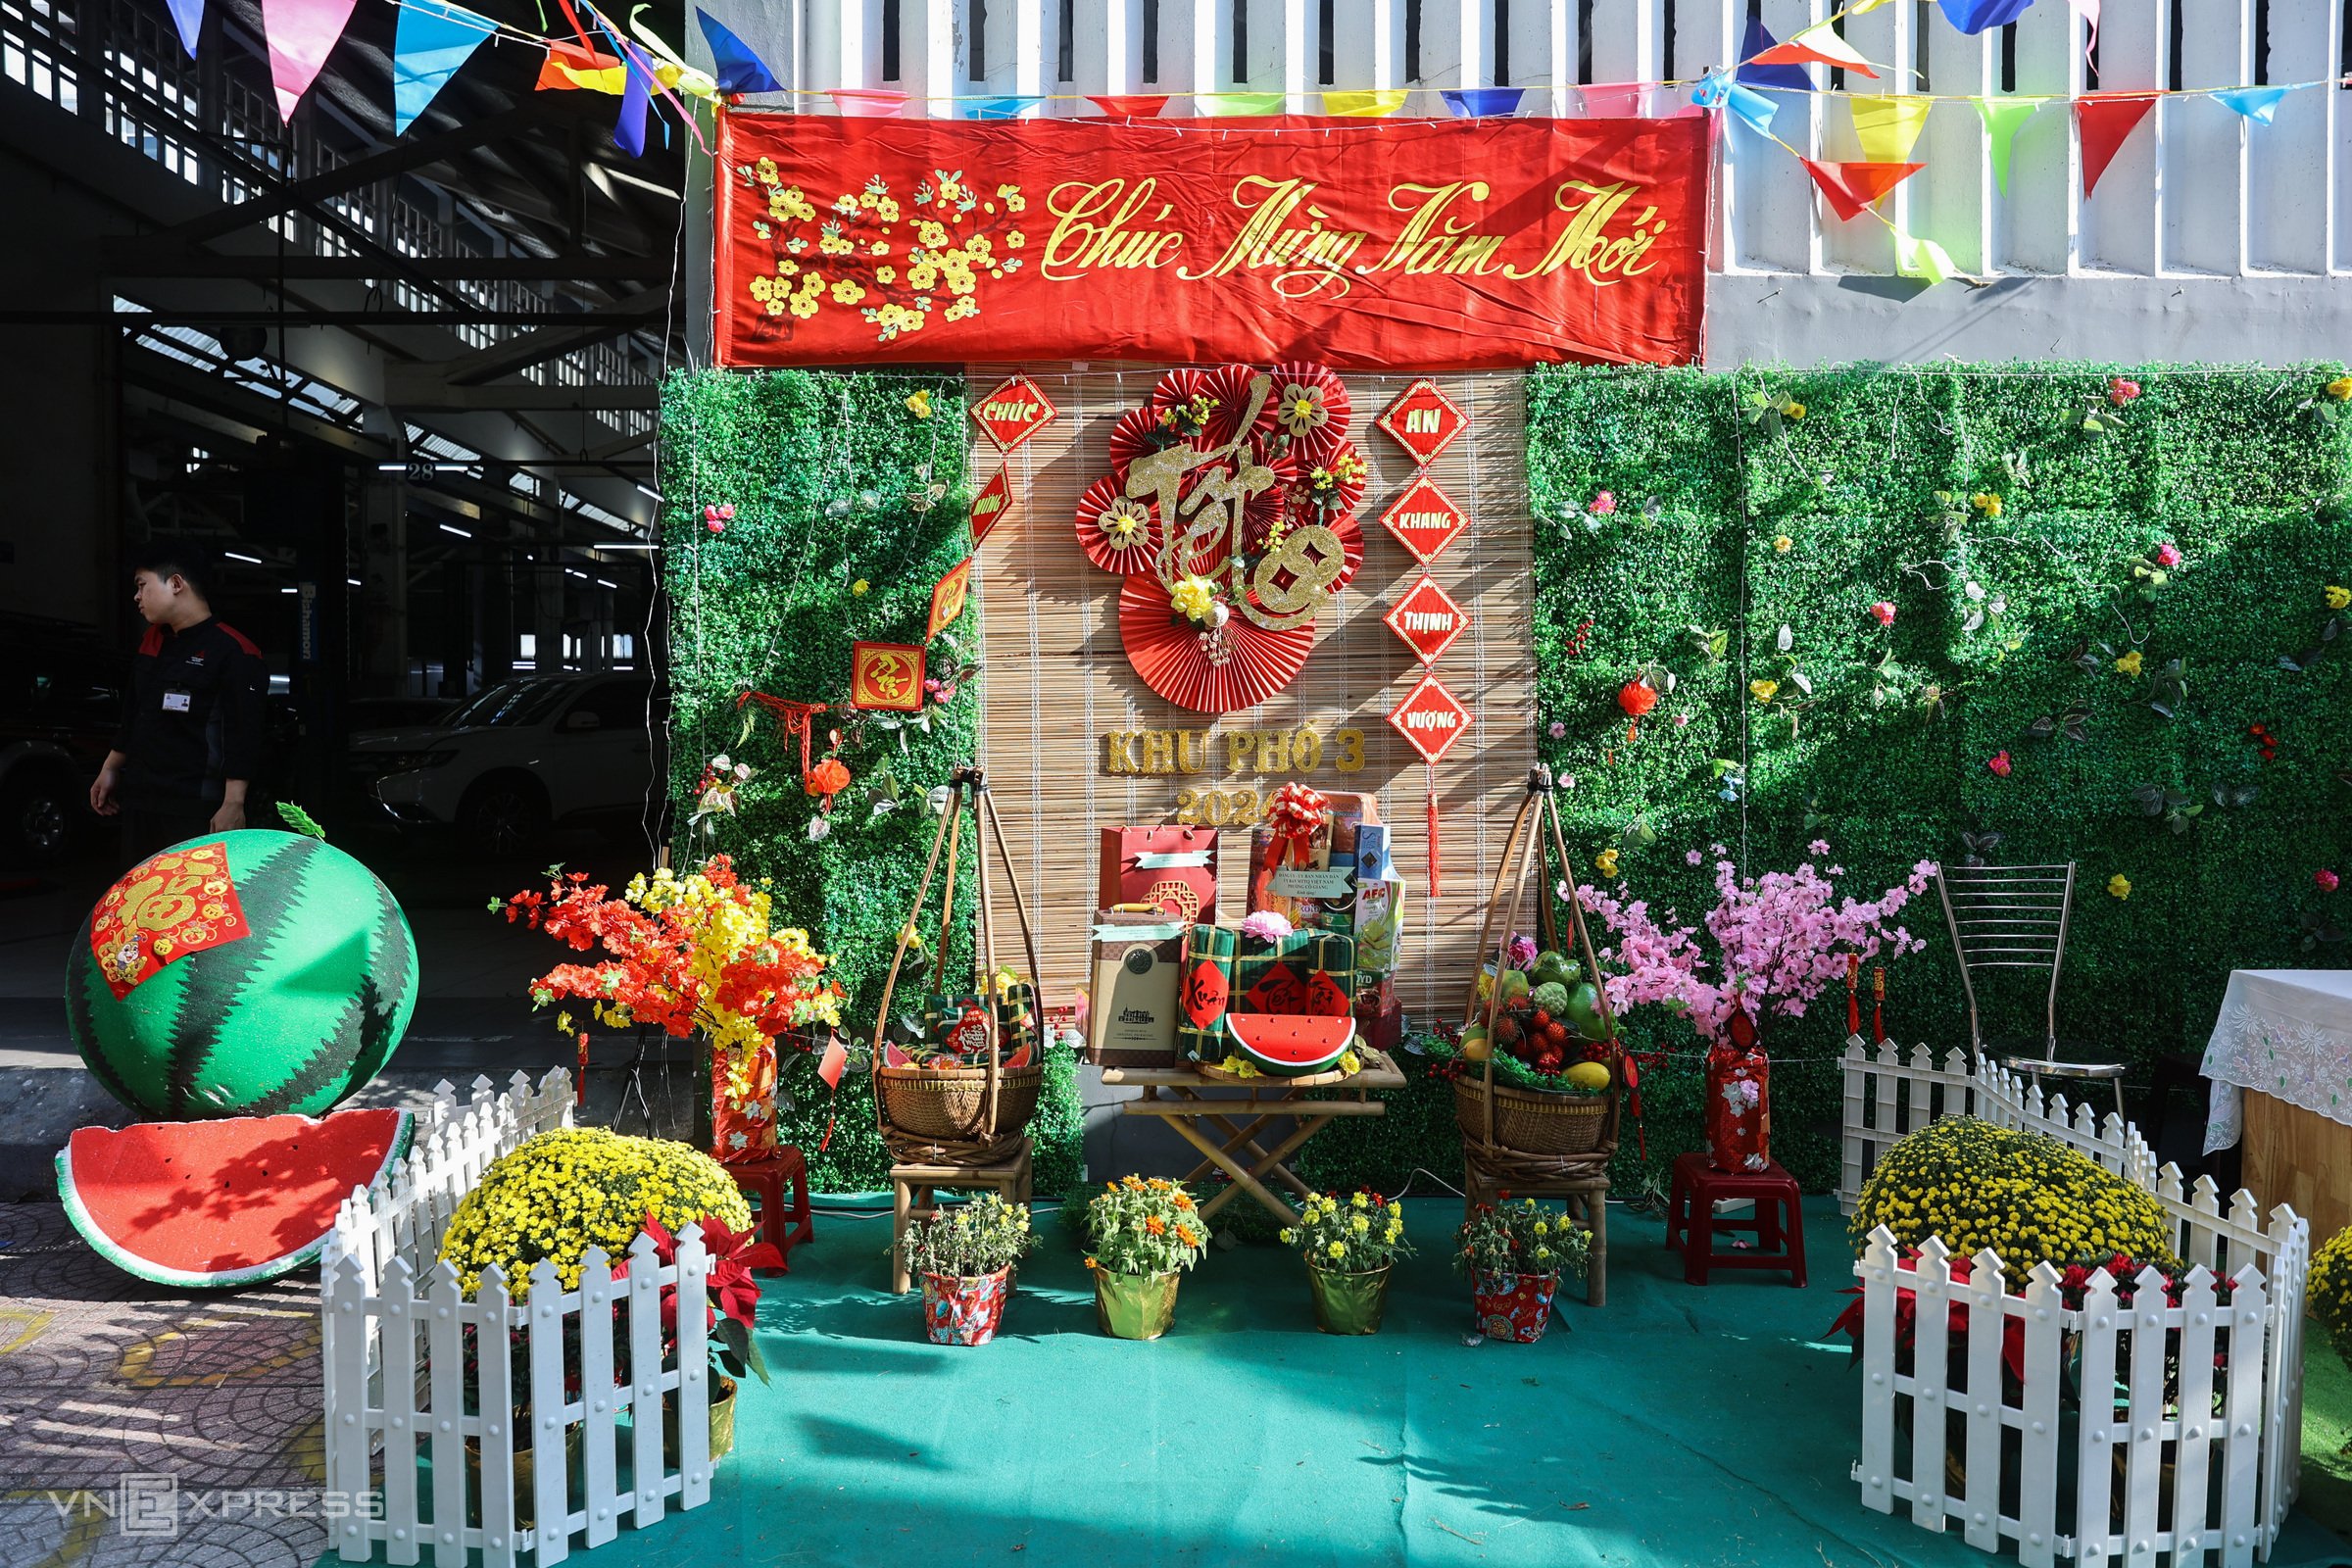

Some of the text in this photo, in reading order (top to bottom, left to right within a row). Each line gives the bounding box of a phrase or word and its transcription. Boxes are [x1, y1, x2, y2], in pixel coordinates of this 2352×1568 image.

[1041, 174, 1667, 300] Chúc Mừng Năm Mới
[983, 399, 1040, 423] CHÚC
[1405, 408, 1442, 434] AN
[408, 463, 434, 481] 28
[1399, 512, 1451, 529] KHANG
[1404, 611, 1454, 635] THỊNH
[1406, 710, 1457, 732] VƯỢNG
[1106, 719, 1366, 774] KHU PHỐ 3
[1362, 888, 1386, 900] AFC
[1186, 977, 1225, 1011] Xuân
